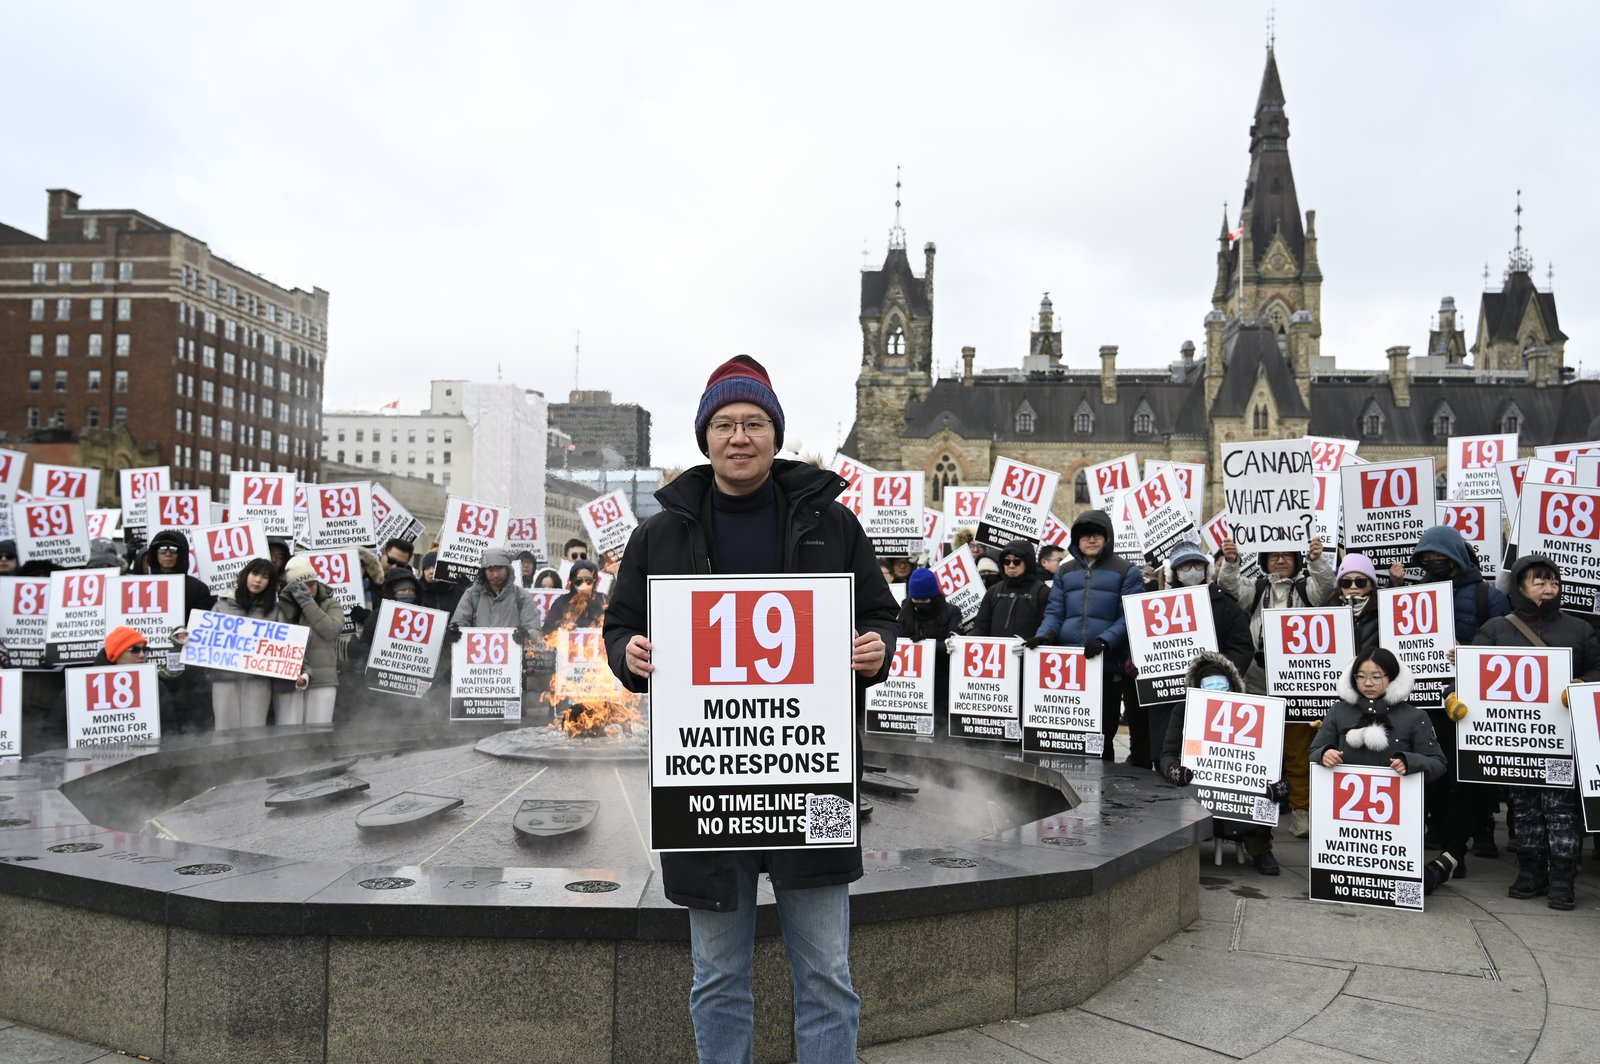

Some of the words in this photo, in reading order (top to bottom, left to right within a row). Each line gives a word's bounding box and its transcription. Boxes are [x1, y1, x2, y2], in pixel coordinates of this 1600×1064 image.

[1312, 444, 1341, 471] 23
[1467, 440, 1498, 468] 19
[1224, 450, 1313, 478] CANADA
[50, 471, 83, 497] 27
[1006, 468, 1040, 501] 30
[1099, 466, 1123, 495] 27
[1368, 469, 1410, 507] 70
[247, 477, 279, 505] 27
[877, 477, 907, 505] 42
[1140, 480, 1165, 518] 13
[325, 488, 356, 517] 39
[959, 493, 986, 516] 37
[1001, 499, 1032, 514] MONTHS
[1225, 489, 1274, 514] WHAT
[1276, 489, 1310, 512] ARE
[163, 496, 194, 525] 43
[592, 500, 621, 527] 39
[991, 506, 1021, 520] WAITING
[1022, 515, 1037, 525] FOR
[1148, 506, 1172, 528] MONTHS
[1368, 510, 1411, 521] MONTHS
[1546, 493, 1593, 536] 68
[32, 505, 67, 536] 39
[326, 520, 357, 528] MONTHS
[462, 505, 494, 536] 39
[985, 513, 1001, 523] IRCC
[1001, 518, 1039, 535] RESPONSE
[1357, 522, 1400, 533] WAITING
[1404, 520, 1423, 529] FOR
[319, 529, 350, 537] WAITING
[510, 519, 537, 540] 25
[1229, 523, 1255, 545] YOU
[1260, 514, 1312, 543] DOING?
[36, 539, 70, 548] MONTHS
[214, 527, 248, 558] 40
[333, 535, 370, 544] RESPONSE
[1544, 541, 1591, 553] MONTHS
[28, 549, 62, 558] WAITING
[65, 547, 80, 555] FOR
[937, 558, 965, 595] 55
[67, 576, 99, 607] 19
[128, 581, 161, 613] 11
[65, 611, 98, 619] MONTHS
[1148, 596, 1191, 635] 34
[1398, 592, 1432, 634] 30
[56, 620, 88, 628] WAITING
[200, 612, 244, 633] STOP
[252, 621, 289, 640] THE
[394, 610, 428, 642] 39
[709, 592, 796, 684] 19
[1287, 615, 1329, 653] 30
[390, 642, 422, 654] MONTHS
[470, 633, 507, 664] 36
[1153, 637, 1193, 650] MONTHS
[1399, 639, 1434, 650] MONTHS
[380, 650, 412, 661] WAITING
[413, 656, 428, 664] FOR
[968, 643, 1001, 678] 34
[1144, 650, 1185, 662] WAITING
[1289, 659, 1331, 668] MONTHS
[373, 658, 391, 667] IRCC
[391, 661, 431, 674] RESPONSE
[1044, 653, 1080, 690] 31
[1279, 671, 1320, 679] WAITING
[1486, 655, 1541, 701] 20
[93, 672, 133, 710] 18
[884, 681, 916, 689] MONTHS
[968, 682, 1000, 691] MONTHS
[876, 690, 907, 699] WAITING
[959, 692, 991, 701] WAITING
[994, 694, 1008, 702] FOR
[1044, 695, 1080, 704] MONTHS
[704, 698, 799, 719] MONTHS
[889, 701, 928, 709] RESPONSE
[954, 702, 971, 710] IRCC
[972, 703, 1013, 713] RESPONSE
[1034, 705, 1070, 715] WAITING
[1073, 707, 1090, 716] FOR
[1487, 708, 1540, 719] MONTHS
[93, 713, 135, 724] MONTHS
[971, 718, 1004, 727] TIMELINES
[1029, 716, 1047, 724] IRCC
[1049, 717, 1095, 727] RESPONSE
[1211, 702, 1257, 746] 42
[82, 724, 124, 735] WAITING
[128, 722, 146, 731] FOR
[679, 726, 774, 747] WAITING
[783, 725, 825, 745] FOR
[975, 727, 1002, 735] RESULTS
[1473, 721, 1526, 733] WAITING
[1531, 724, 1555, 734] FOR
[76, 737, 98, 747] IRCC
[100, 733, 153, 745] RESPONSE
[1048, 732, 1085, 742] TIMELINES
[1466, 734, 1493, 745] IRCC
[1495, 736, 1564, 749] RESPONSE
[1052, 742, 1082, 751] RESULTS
[1208, 747, 1255, 761] MONTHS
[666, 755, 715, 776] IRCC
[720, 752, 839, 774] RESPONSE
[1195, 758, 1242, 772] WAITING
[1246, 764, 1267, 775] FOR
[1479, 755, 1492, 764] NO
[1483, 767, 1497, 776] NO
[1501, 768, 1546, 779] RESULTS
[690, 795, 714, 812] NO
[1339, 774, 1393, 823] 25
[697, 817, 723, 834] NO
[729, 815, 806, 833] RESULTS
[1339, 827, 1392, 841] MONTHS
[1326, 840, 1378, 854] WAITING
[1382, 845, 1406, 857] FOR
[1318, 853, 1345, 864] IRCC
[1347, 856, 1414, 872] RESPONSE
[1331, 874, 1344, 883] NO
[1335, 886, 1349, 895] NO
[1352, 888, 1395, 900] RESULTS
